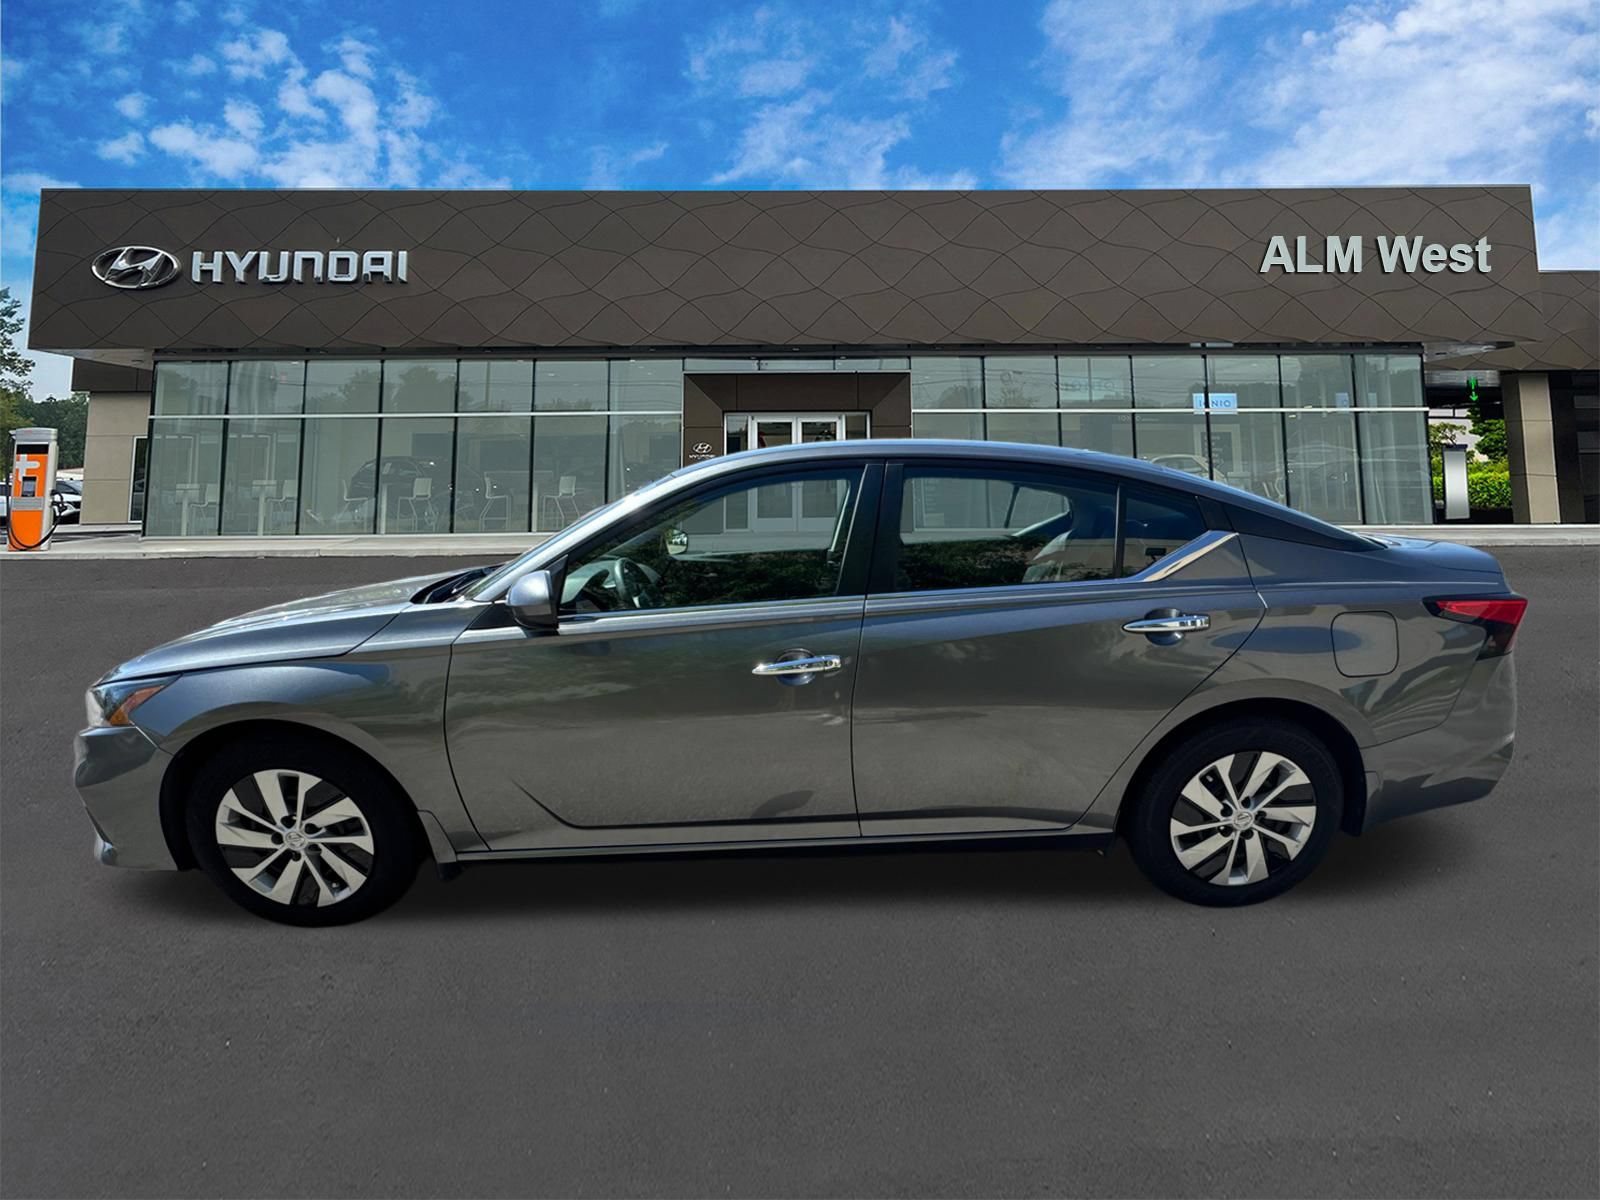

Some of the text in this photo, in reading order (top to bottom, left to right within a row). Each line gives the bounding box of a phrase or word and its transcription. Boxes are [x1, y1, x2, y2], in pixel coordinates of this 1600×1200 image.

[191, 250, 409, 284] HYUNDAI
[1260, 235, 1492, 273] ALM West
